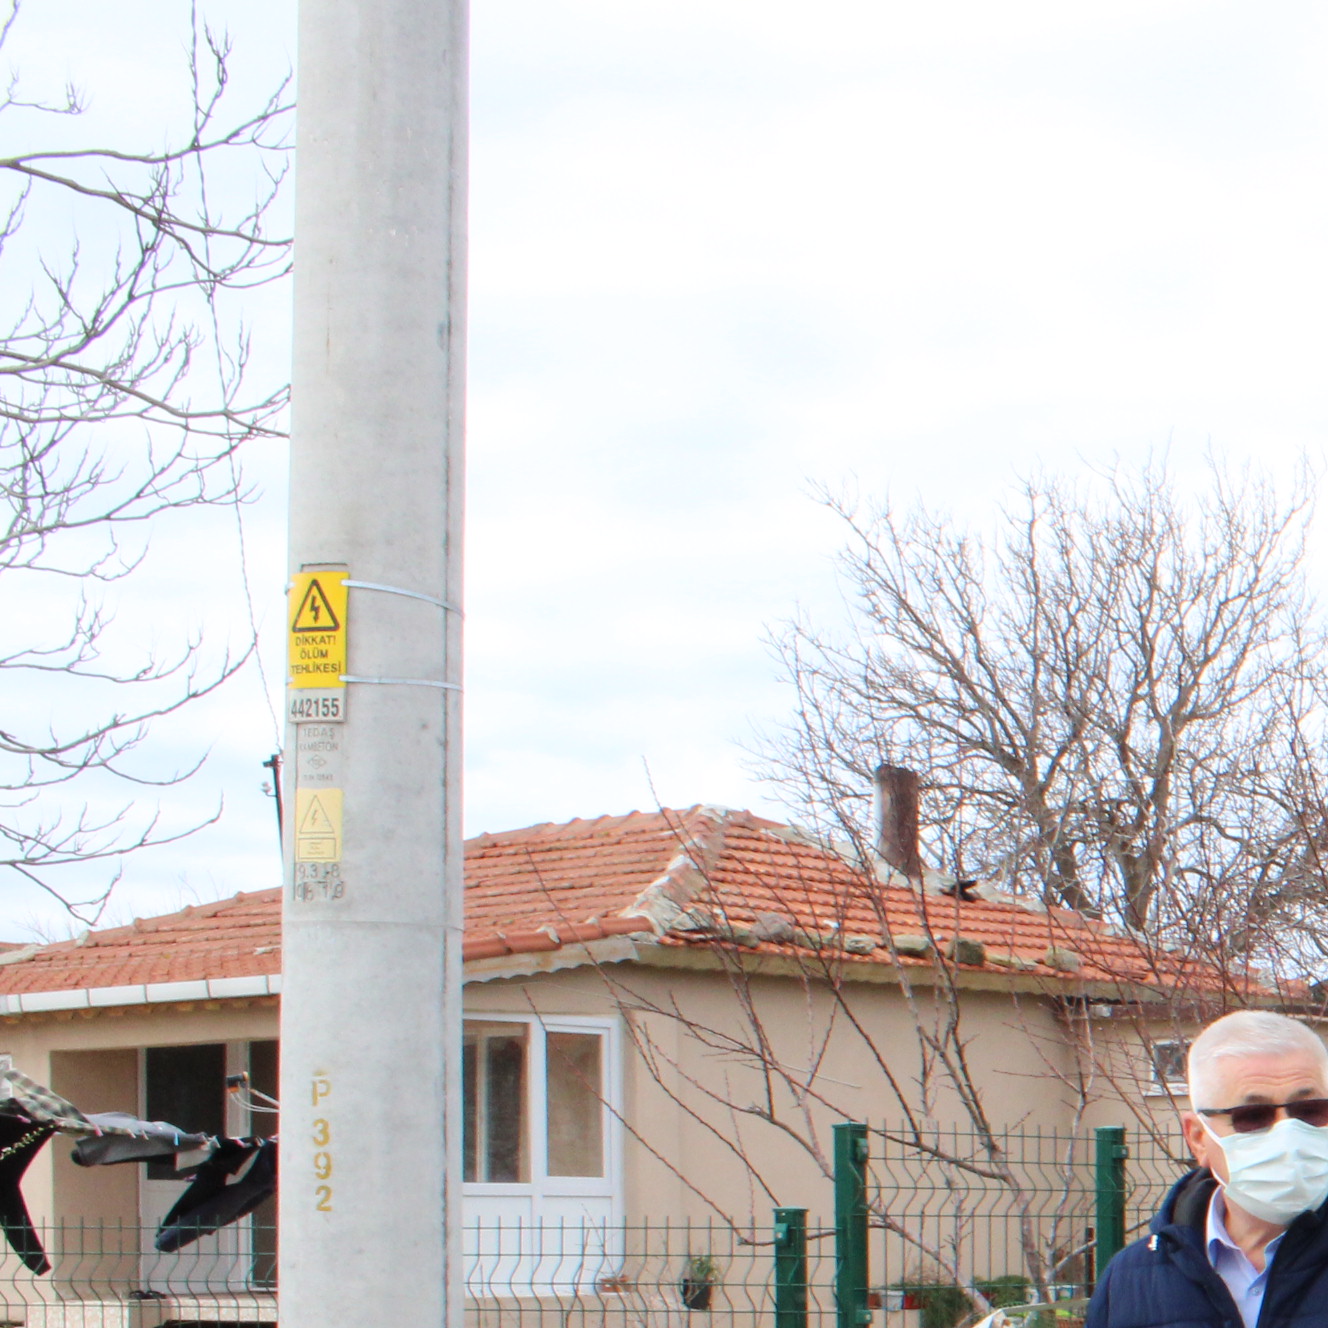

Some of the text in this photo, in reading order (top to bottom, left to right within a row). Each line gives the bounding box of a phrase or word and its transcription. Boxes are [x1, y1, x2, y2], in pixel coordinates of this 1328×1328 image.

[300, 647, 329, 659] ÖLÜM
[291, 661, 342, 674] TEHLİKESİ
[291, 698, 340, 717] 442155
